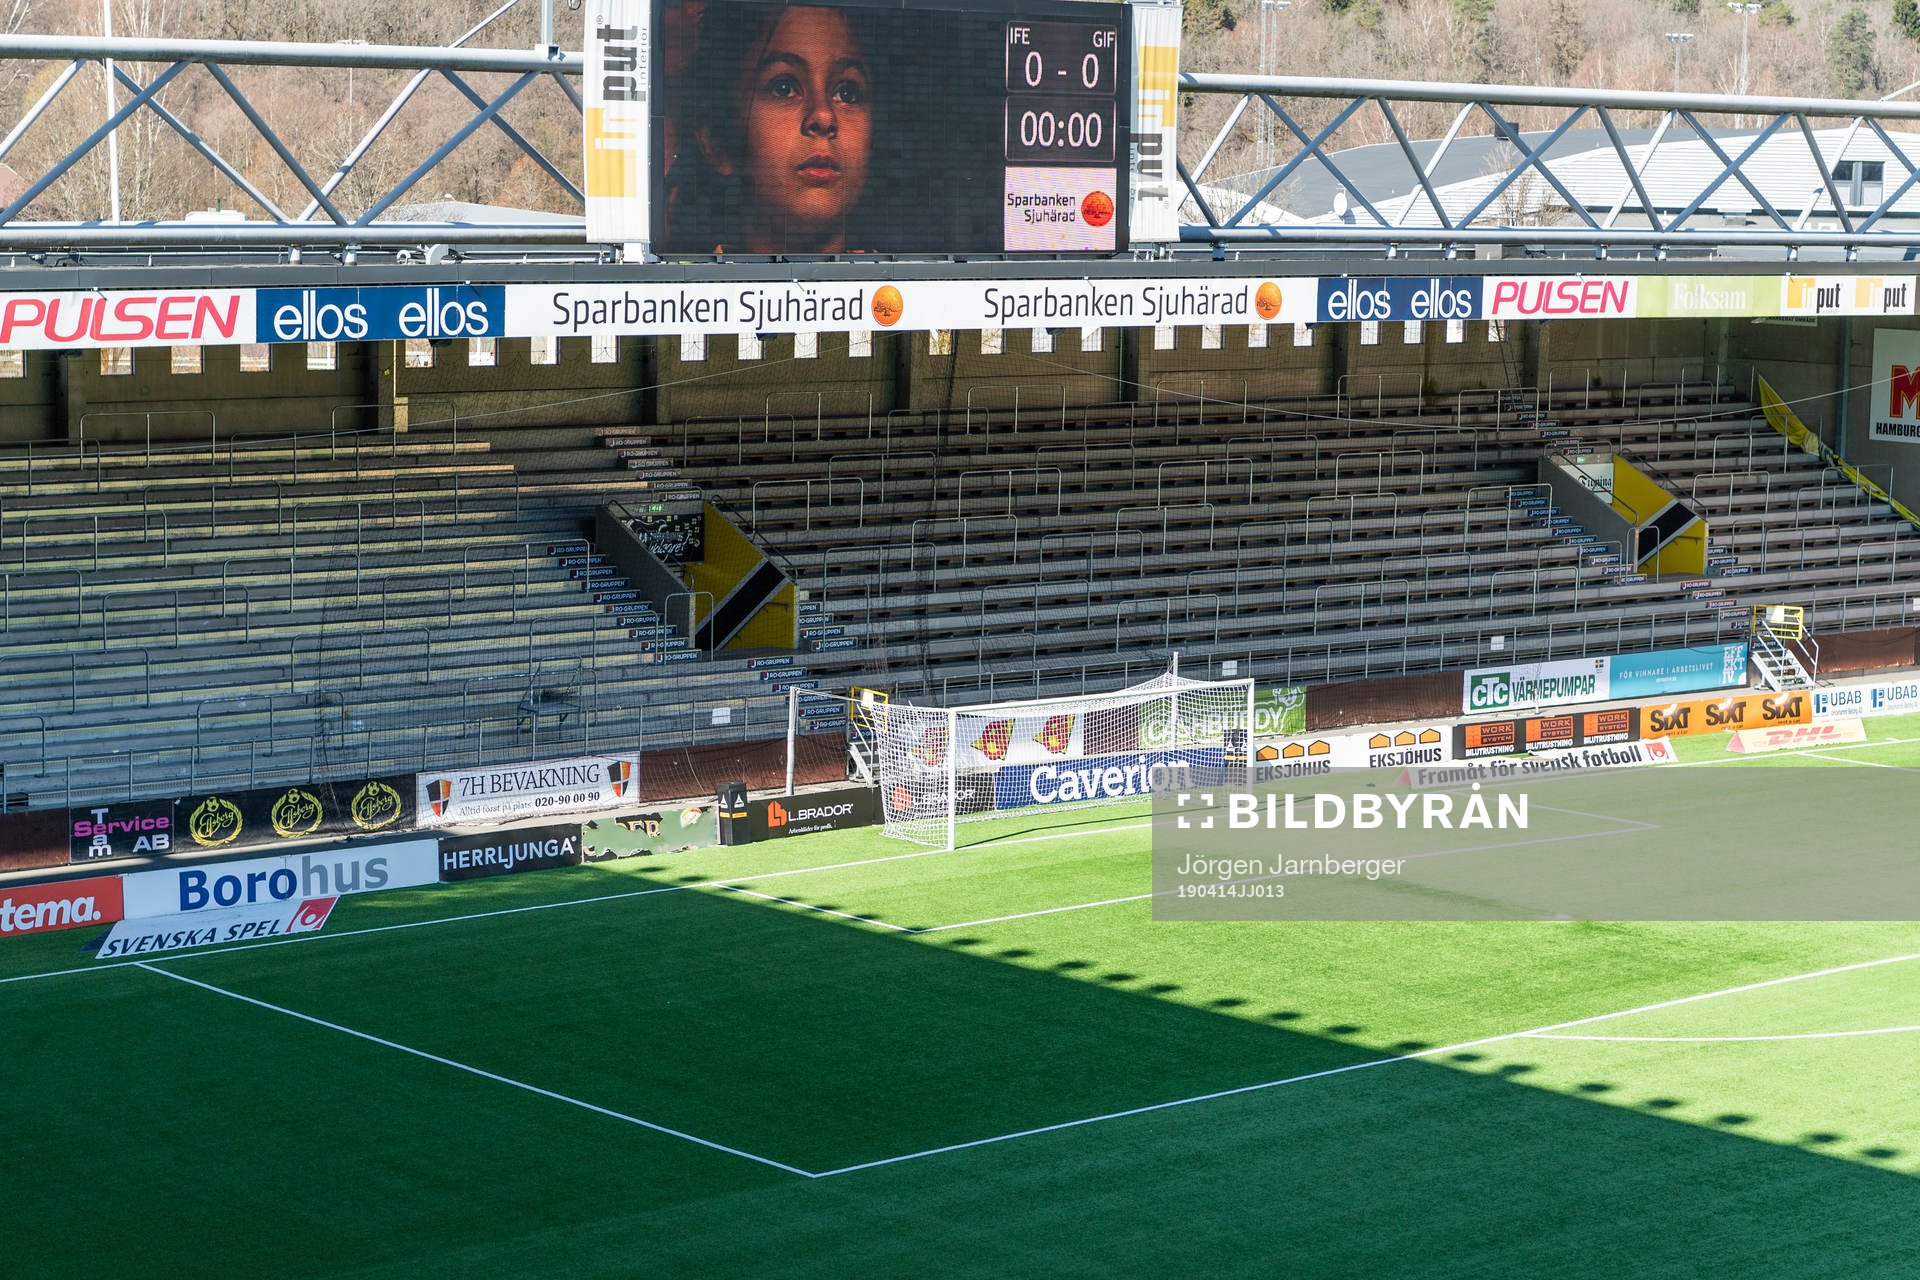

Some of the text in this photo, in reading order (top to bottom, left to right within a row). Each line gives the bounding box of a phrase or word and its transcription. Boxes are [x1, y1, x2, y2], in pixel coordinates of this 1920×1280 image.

[1010, 27, 1030, 45] IFE
[1093, 31, 1115, 48] GIF
[1025, 51, 1042, 87] 0
[1082, 53, 1099, 89] 0
[1020, 110, 1102, 147] 00:00
[1007, 193, 1075, 208] Sparbanken
[1024, 209, 1075, 224] Sjuhärad
[553, 288, 863, 332] Sparbanken Sjuhärad
[984, 283, 1248, 323] Sparbanken Sjuhärad
[1328, 279, 1392, 319] ellos
[1410, 279, 1473, 319] ellos
[1491, 280, 1629, 315] PULSEN
[1672, 283, 1747, 310] Folksam
[0, 296, 239, 344] PULSEN
[274, 290, 369, 340] ellos
[399, 287, 489, 338] ellos
[1511, 674, 1596, 702] VÄRMEPUMPAR
[1831, 690, 1862, 706] UBAB
[1887, 685, 1918, 701] UBAB
[1481, 725, 1512, 734] WORK
[1541, 719, 1571, 728] WORK
[1599, 713, 1628, 722] WORK
[1482, 735, 1512, 743] SYSTEM
[1766, 726, 1841, 746] DHL
[1255, 759, 1331, 782] EKSJÖHUS
[1369, 748, 1442, 768] EKSJÖHUS
[1418, 762, 1486, 785] Framåt
[1490, 758, 1518, 778] för
[1582, 745, 1642, 767] fotboll
[459, 764, 600, 797] 7H BEVAKNING
[1030, 755, 1194, 803] Caverion
[573, 792, 586, 803] 00
[588, 791, 600, 802] 90
[788, 804, 851, 821] L.BRADOR
[74, 816, 170, 837] Service
[132, 833, 170, 853] AB
[443, 837, 577, 871] HERRLJUNGA
[179, 855, 389, 912] Borohus
[103, 918, 281, 957] SVENSKA SPEL
